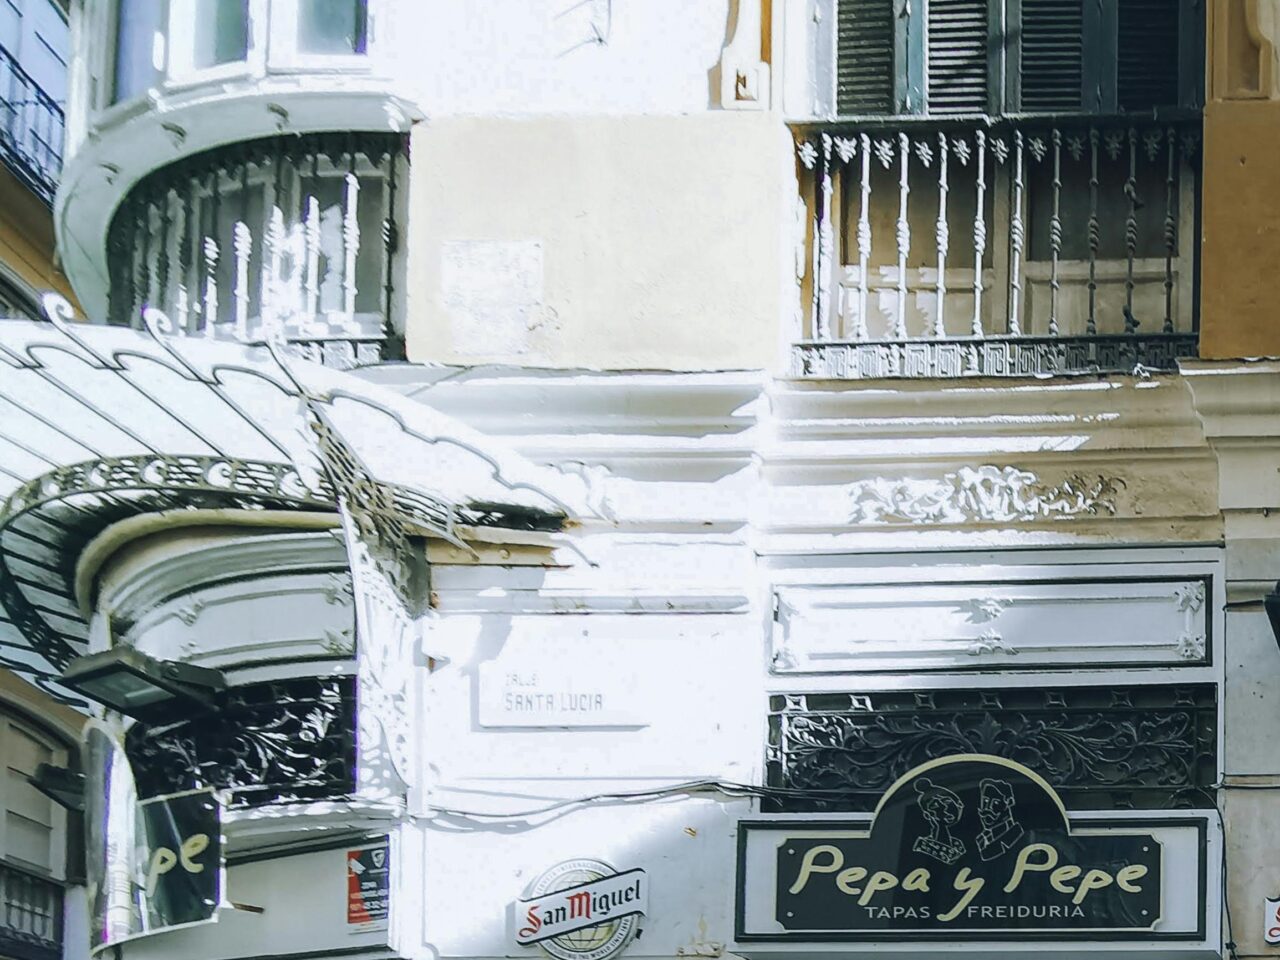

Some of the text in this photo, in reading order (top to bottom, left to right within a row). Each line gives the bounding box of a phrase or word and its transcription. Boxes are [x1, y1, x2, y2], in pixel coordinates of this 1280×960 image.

[505, 693, 554, 711] SANTA
[789, 843, 1148, 922] Pepa y Pepe
[865, 907, 931, 919] TAPAS
